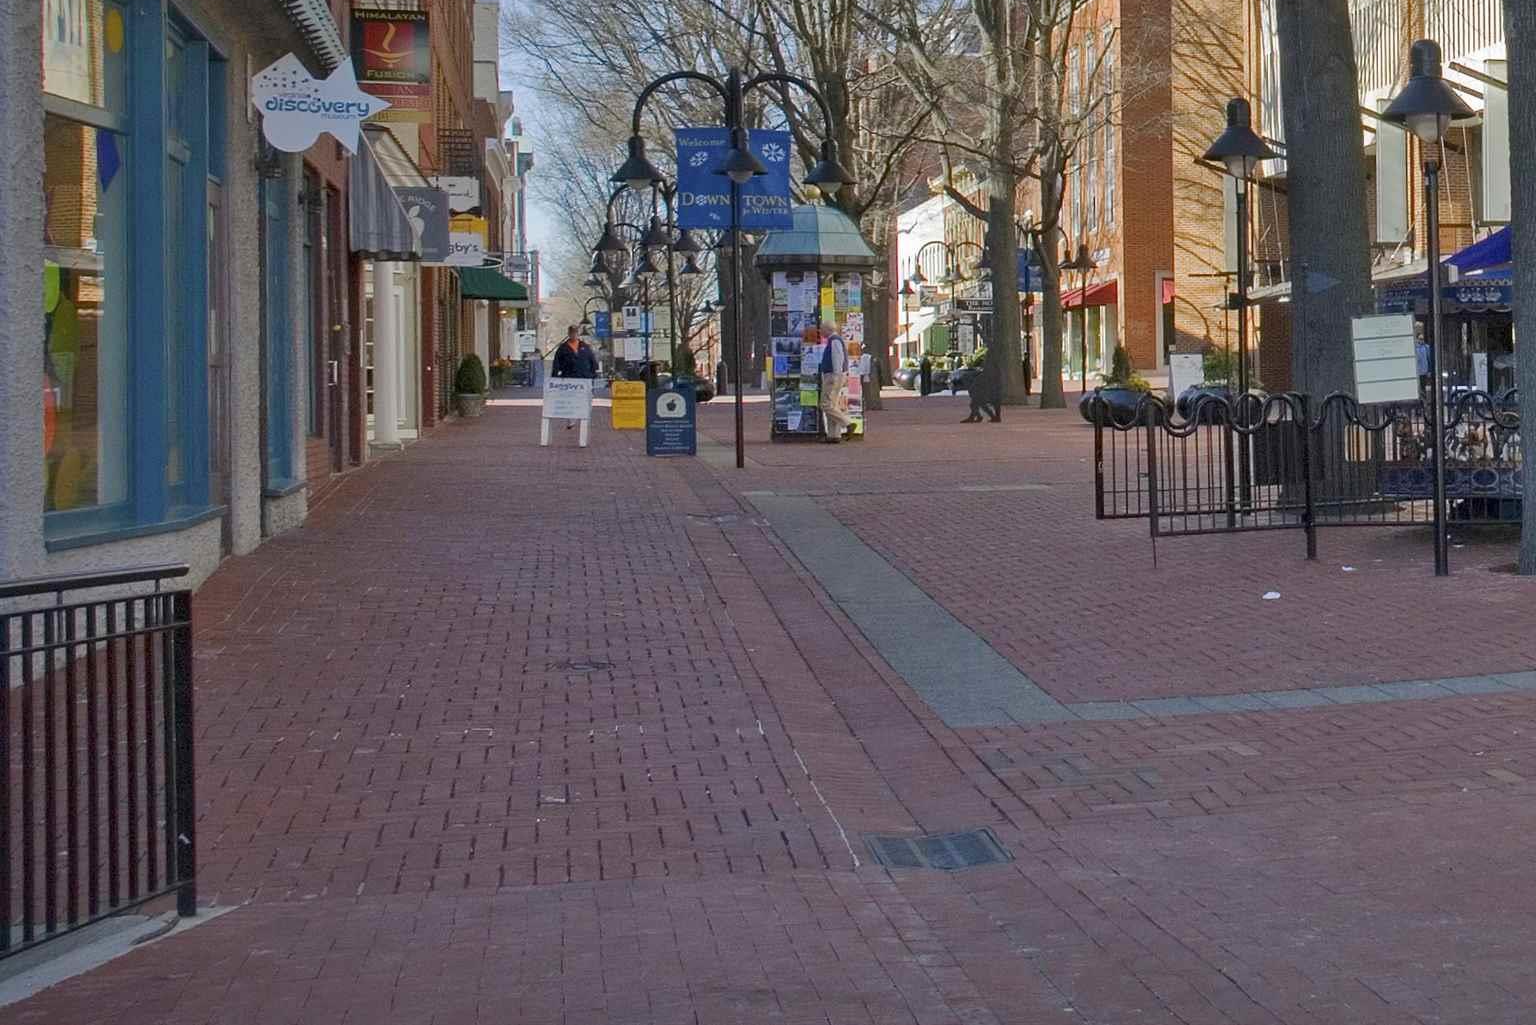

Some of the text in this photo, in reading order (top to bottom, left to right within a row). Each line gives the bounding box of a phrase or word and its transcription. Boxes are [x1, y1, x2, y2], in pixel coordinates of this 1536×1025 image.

[354, 10, 426, 21] HIMALAYAN
[265, 96, 370, 117] discovery
[678, 136, 727, 147] Welcome
[741, 194, 788, 207] TOWN
